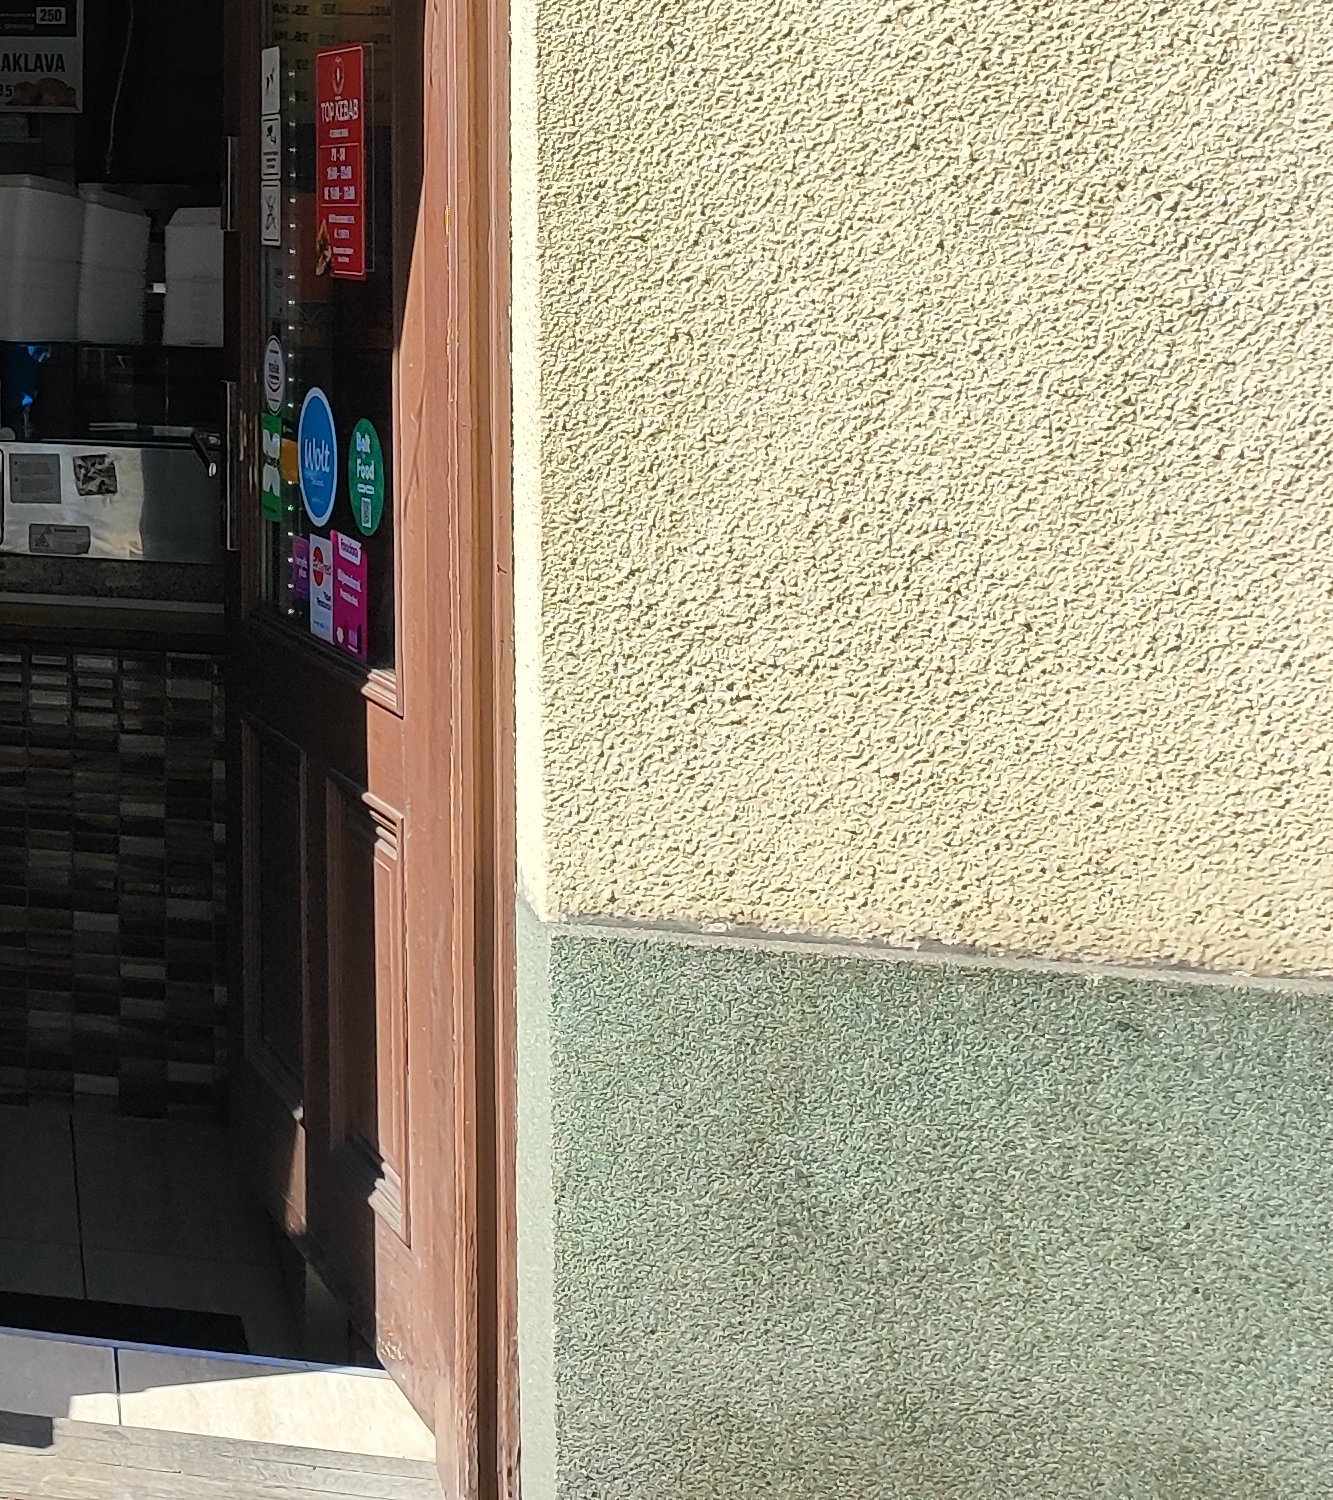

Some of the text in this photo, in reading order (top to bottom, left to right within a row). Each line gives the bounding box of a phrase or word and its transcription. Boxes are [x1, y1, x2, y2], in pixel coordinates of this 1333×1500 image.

[40, 9, 61, 21] 250
[321, 99, 359, 122] TOP KEBAB
[304, 439, 330, 473] Wolt
[357, 459, 374, 480] Food
